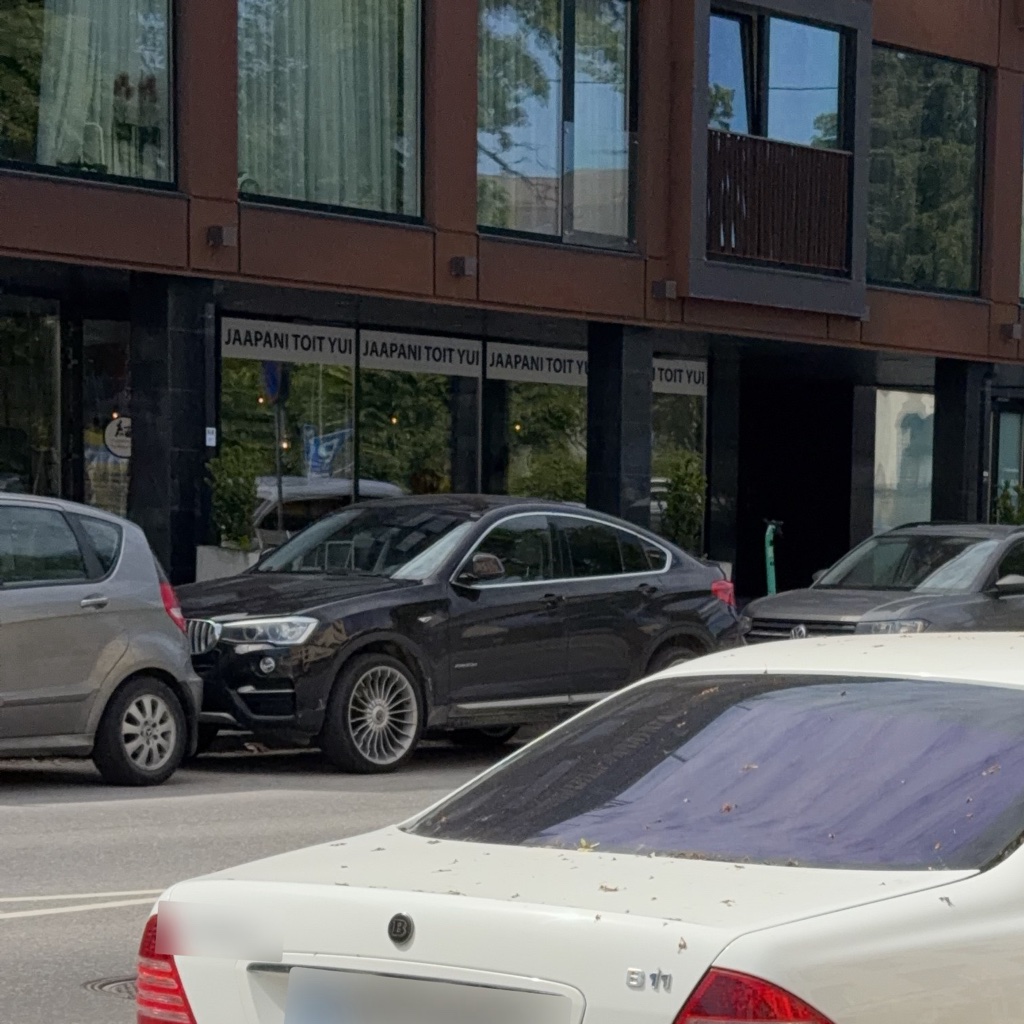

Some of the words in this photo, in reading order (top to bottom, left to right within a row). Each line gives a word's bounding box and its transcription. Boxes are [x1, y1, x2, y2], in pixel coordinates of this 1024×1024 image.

[224, 328, 289, 351] JAAPANI
[291, 333, 326, 352] TOIT
[329, 337, 353, 355] YUI
[362, 340, 421, 361] JAAPANI
[424, 346, 454, 363] TOIT
[456, 349, 480, 366] YUI
[489, 352, 544, 372] JAAPANI
[547, 357, 574, 374] TOIT
[657, 367, 684, 384] TOIT
[685, 369, 705, 384] YUI
